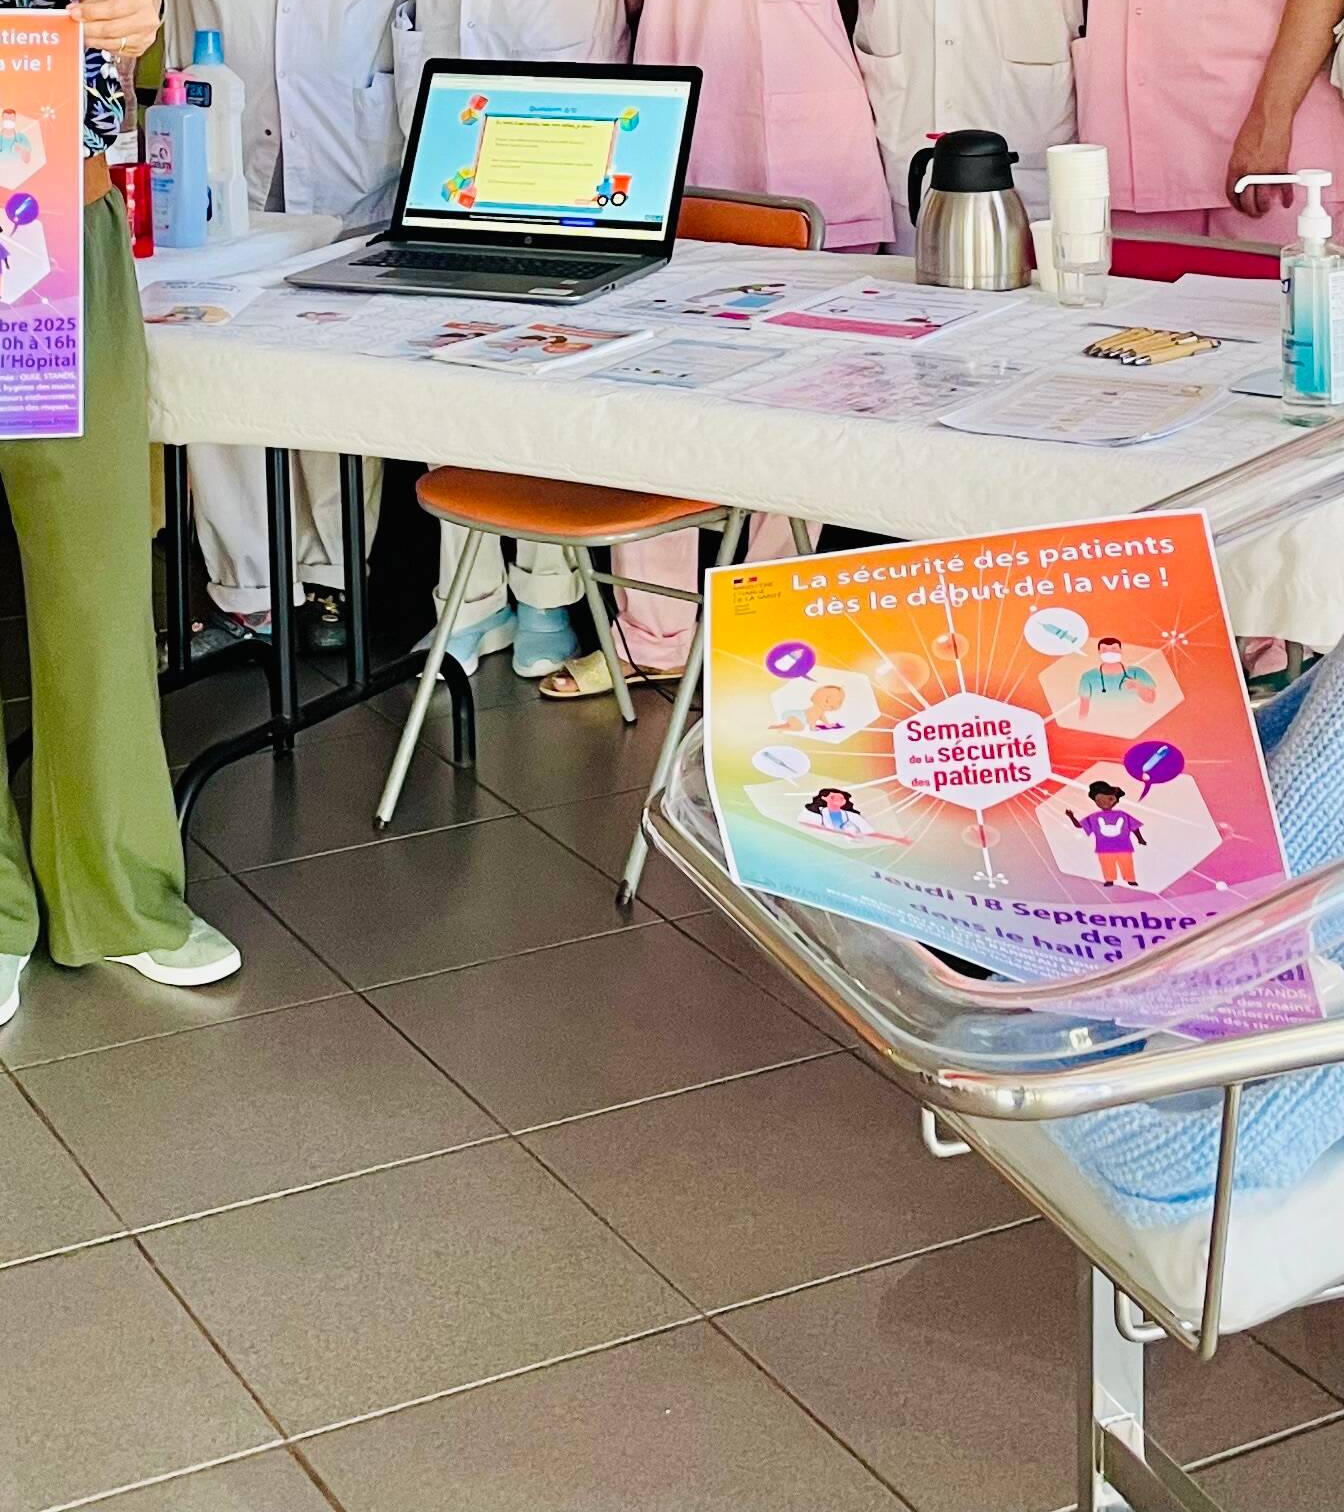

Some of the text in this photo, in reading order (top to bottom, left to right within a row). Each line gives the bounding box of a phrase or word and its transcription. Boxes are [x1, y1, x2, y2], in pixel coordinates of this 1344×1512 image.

[11, 55, 41, 71] vie
[46, 54, 52, 71] !
[32, 317, 76, 332] 2025
[28, 335, 39, 351] à
[44, 334, 76, 350] 16h
[791, 573, 818, 592] La
[837, 553, 965, 588] sécurité
[972, 544, 1031, 571] des
[1039, 534, 1175, 569] patients
[803, 566, 1169, 618] dès le début de la vie !
[906, 715, 1012, 742] Semaine
[909, 734, 1036, 764] de la sécurité
[911, 762, 1032, 792] des patients
[869, 870, 1197, 930] Jeudi 18 Septembre
[909, 902, 987, 933] dans
[995, 925, 1024, 943] le
[1032, 934, 1095, 961] hall
[1081, 929, 1122, 947] de
